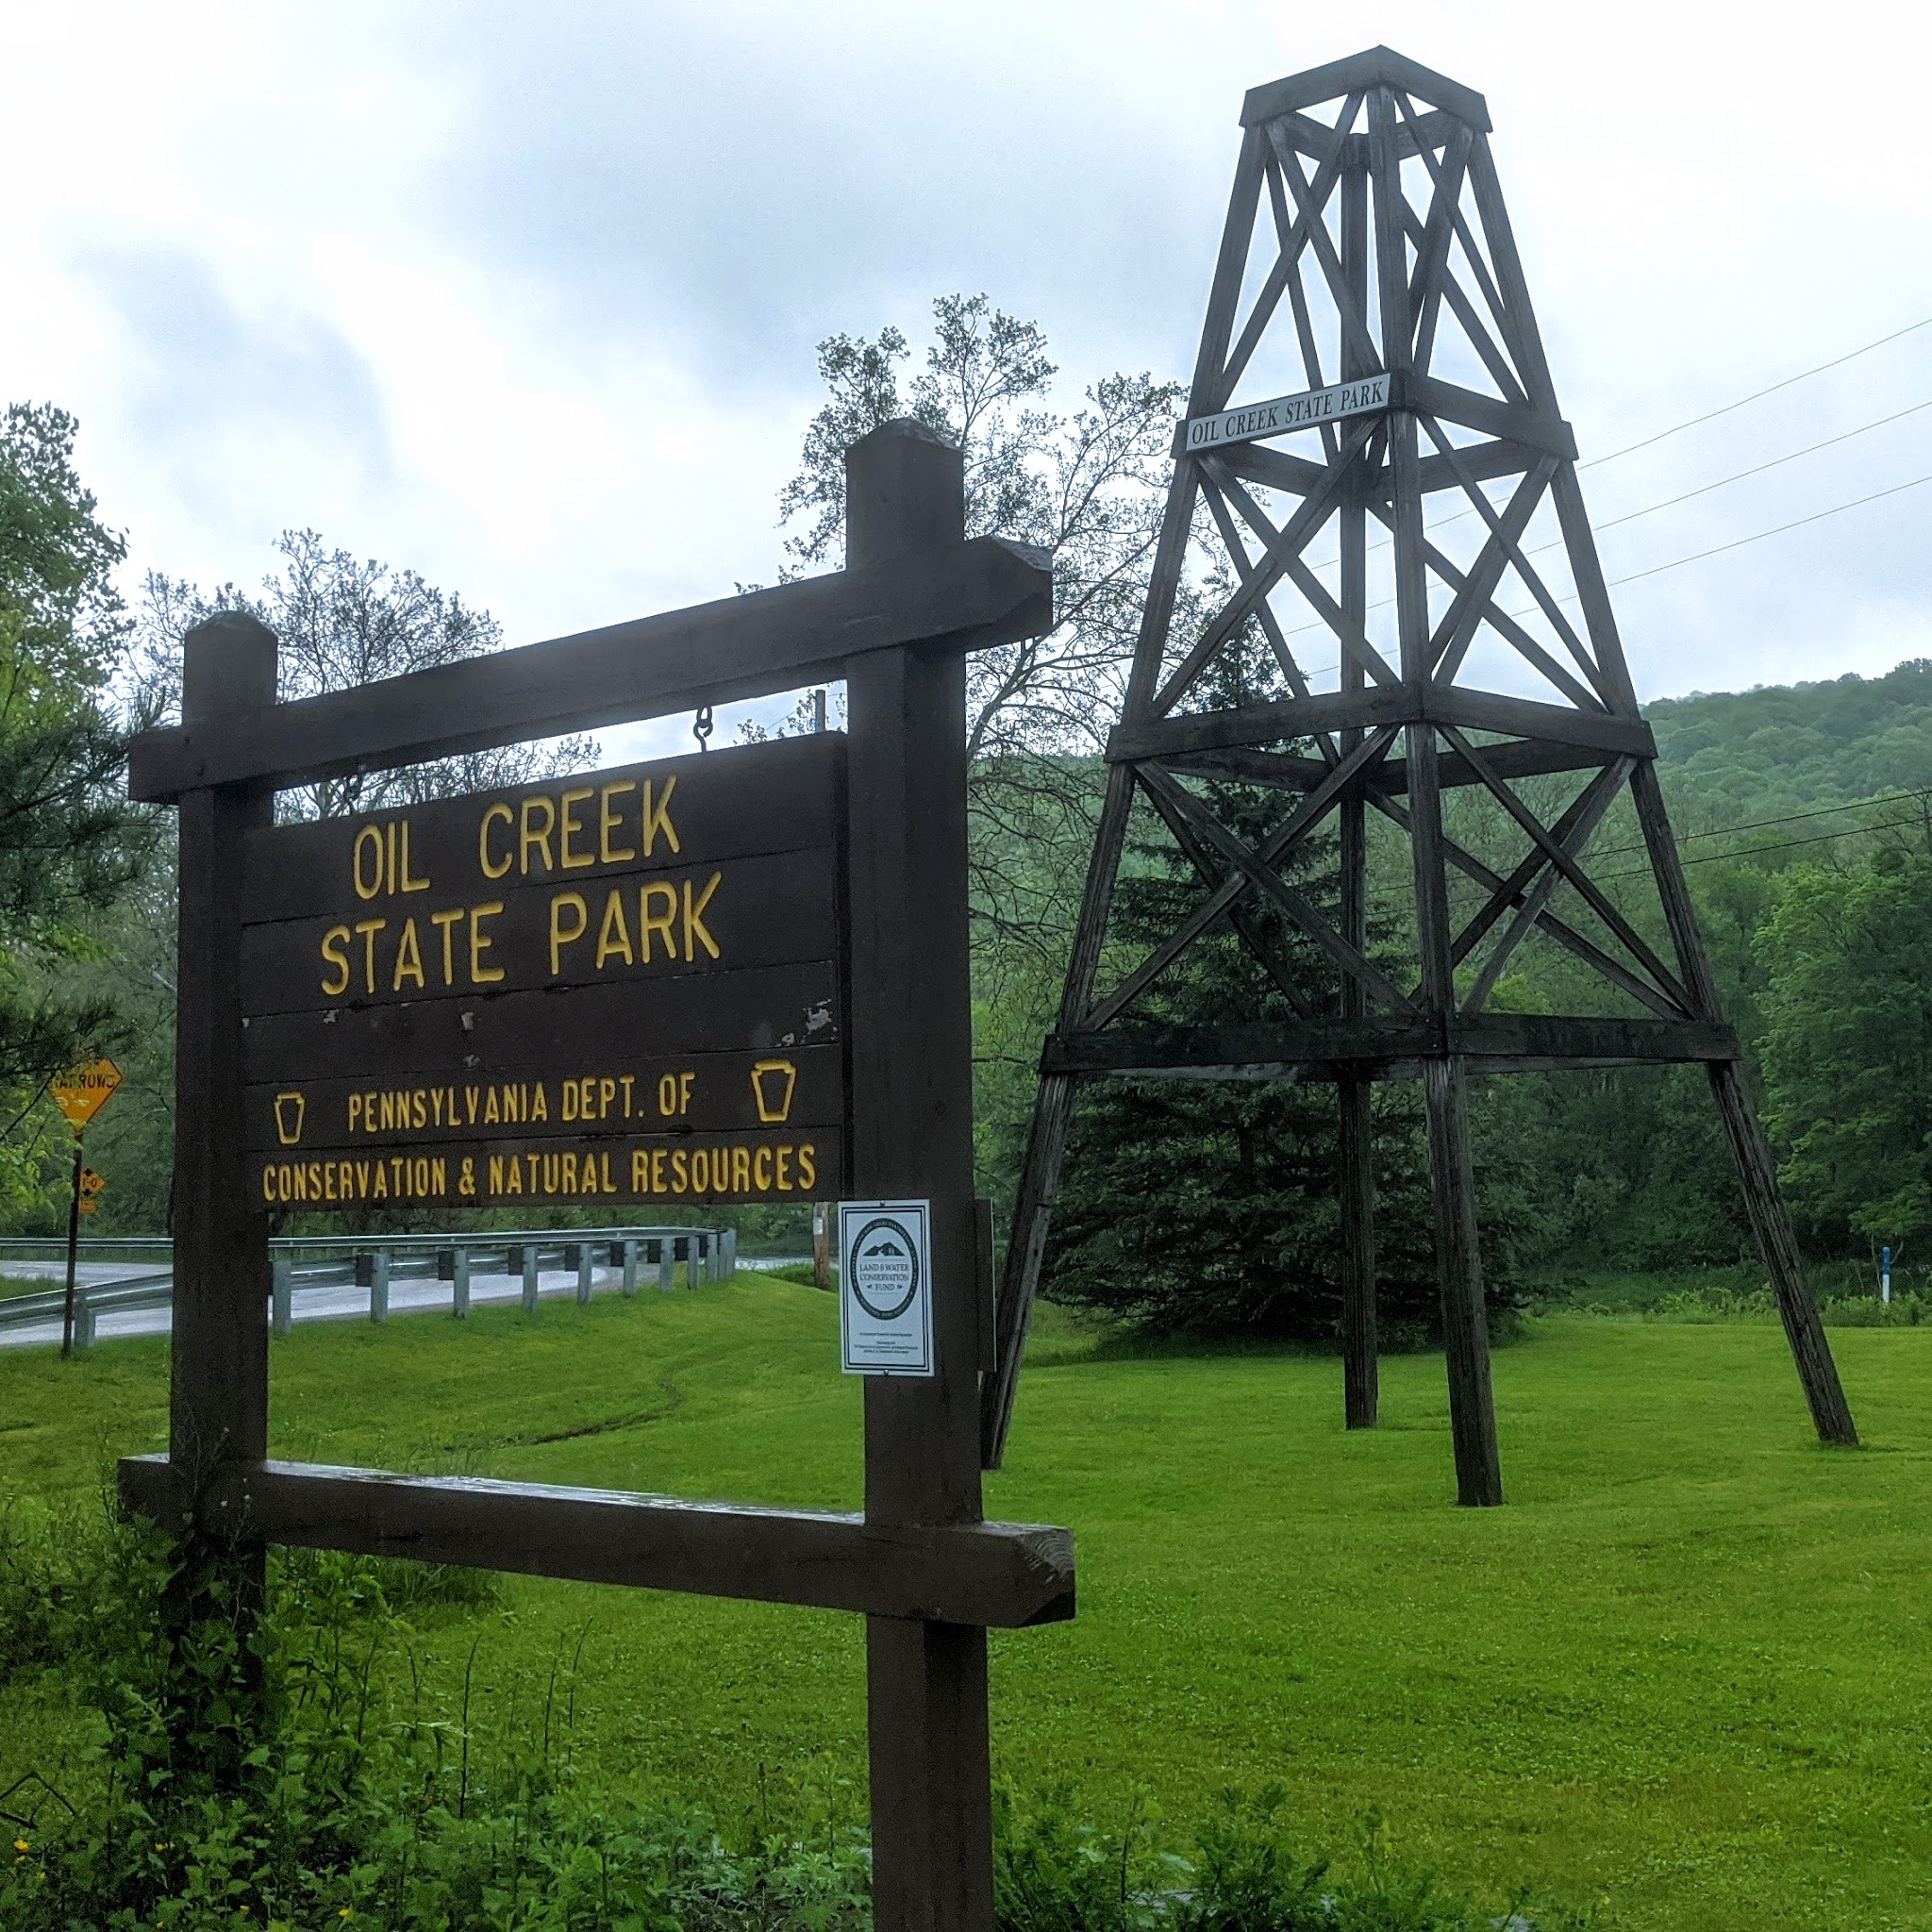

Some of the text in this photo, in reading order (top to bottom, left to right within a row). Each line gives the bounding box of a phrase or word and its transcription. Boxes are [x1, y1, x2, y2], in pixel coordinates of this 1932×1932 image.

[1191, 381, 1384, 444] OIL CREEK STATE PARK
[354, 774, 680, 900] OIL CREEK
[321, 870, 723, 995] STATE PARK
[348, 1072, 695, 1133] PENNSYLVANIA DEPT. OF
[263, 1142, 816, 1202] CONSERVATION & NATURAL RESOURCES
[859, 1263, 879, 1272] LAND
[885, 1263, 909, 1272] WATER
[859, 1274, 909, 1282] CONSERVATION
[874, 1283, 895, 1291] FUND
